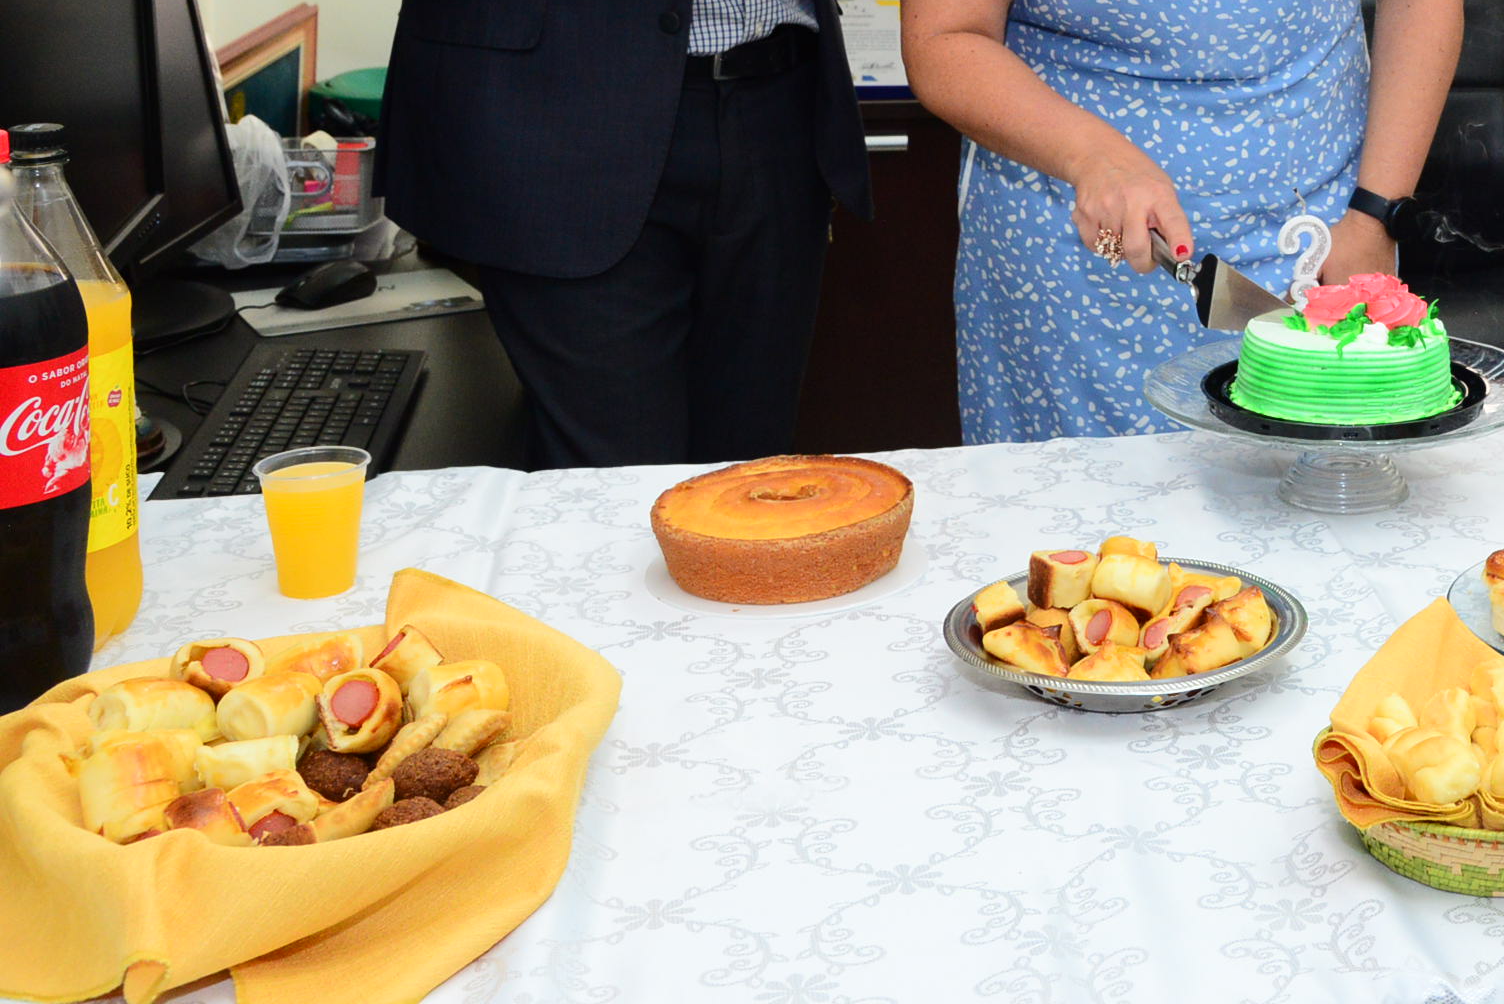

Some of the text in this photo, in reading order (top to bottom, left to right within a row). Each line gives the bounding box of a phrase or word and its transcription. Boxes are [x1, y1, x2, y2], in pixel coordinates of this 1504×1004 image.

[28, 364, 75, 383] O SABOR
[60, 379, 71, 388] DO
